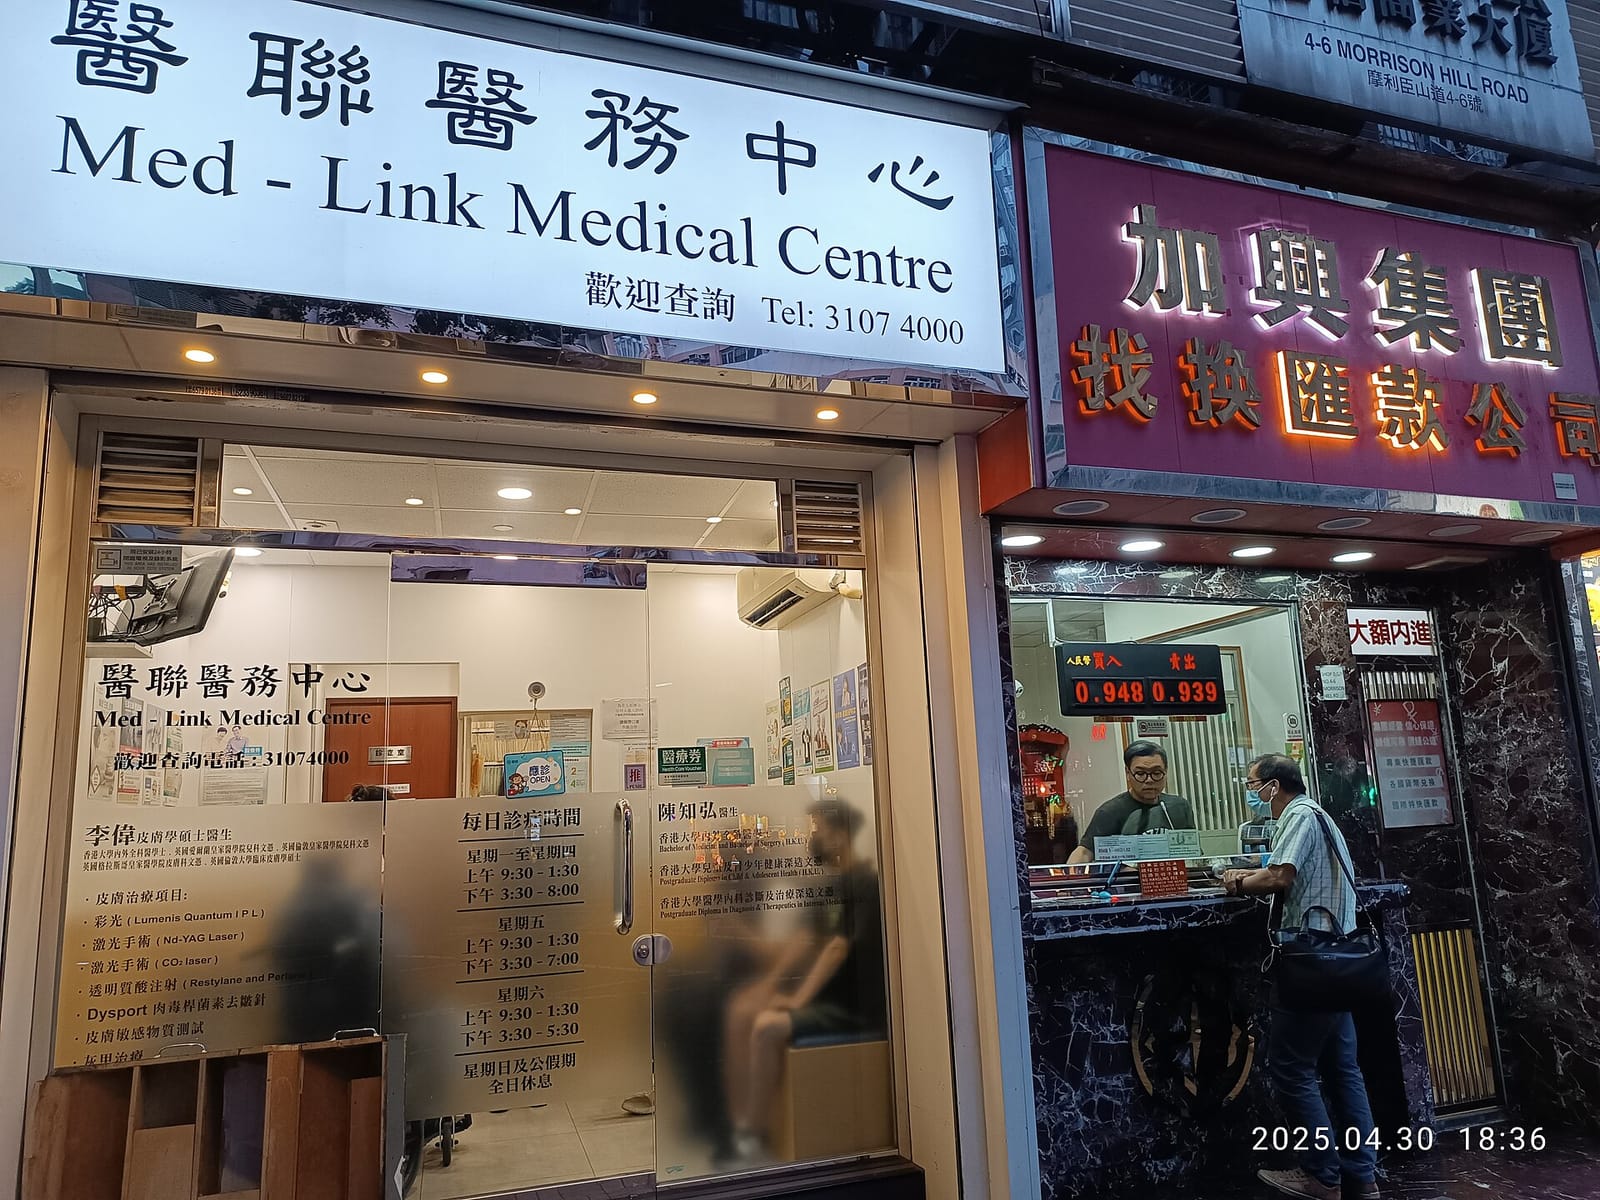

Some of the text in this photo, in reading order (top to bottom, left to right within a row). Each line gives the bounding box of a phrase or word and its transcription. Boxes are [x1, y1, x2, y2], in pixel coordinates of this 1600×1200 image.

[1305, 33, 1528, 103] 4-6 MORRISON HILL ROAD
[51, 0, 954, 210] 醫聯醫務中心
[51, 115, 239, 196] Med
[319, 155, 486, 230] Link
[507, 182, 759, 268] Medical
[778, 225, 953, 294] Centre
[1122, 204, 1563, 369] 加興集團
[585, 271, 964, 344] 歡迎查詢 Tel: 3107 4000
[1071, 323, 1600, 466] 找換匯款公司
[1348, 618, 1433, 646] 大額內進
[1066, 650, 1196, 671] 人民幣 買入 賣出
[100, 664, 370, 699] 醫聯醫務中心
[1075, 681, 1217, 703] 0.948 0.939
[94, 710, 142, 727] Med
[166, 709, 213, 726] Link
[220, 709, 299, 725] Medical
[307, 709, 371, 725] Centre
[662, 749, 701, 764] 醫療券
[530, 776, 550, 784] OPEN
[630, 769, 641, 782] 推
[466, 845, 577, 864] 星期一至星期四
[659, 845, 683, 853] Bachelor
[760, 839, 783, 848] Surgery
[463, 868, 495, 884] 上午
[500, 867, 534, 881] 9:30
[548, 864, 579, 878] 1:30
[660, 877, 696, 886] Postgraduate
[780, 869, 798, 877] Health
[463, 888, 494, 904] 下午
[500, 886, 533, 901] 3:30
[548, 883, 579, 897] 8:00
[94, 915, 123, 928] 彩光
[184, 911, 232, 922] Quantum
[660, 909, 697, 919] Postgraduate
[698, 908, 721, 917] Diploma
[763, 902, 796, 911] Therapeutics
[498, 915, 545, 932] 星期五
[92, 935, 151, 952] 激光手術
[463, 938, 493, 954] 上午
[500, 937, 532, 951] 9:30
[548, 932, 579, 947] 1:30
[91, 957, 150, 975] 激光手術
[462, 958, 493, 975] 下午
[500, 957, 532, 971] 3:30
[547, 952, 579, 967] 7:00
[88, 977, 178, 998] 透明質酸注射
[245, 972, 265, 984] and
[497, 985, 545, 1002] 星期六
[87, 1005, 148, 1022] Dysport
[461, 1010, 493, 1027] 上午
[500, 1007, 532, 1022] 9:30
[547, 1002, 579, 1017] 1:30
[85, 1021, 205, 1045] 皮膚敏感物質測試
[462, 1030, 493, 1047] 下午
[499, 1027, 532, 1042] 3:30
[547, 1022, 579, 1037] 5:30
[463, 1053, 577, 1079] 星期日及公假期
[488, 1073, 553, 1095] 全日休息
